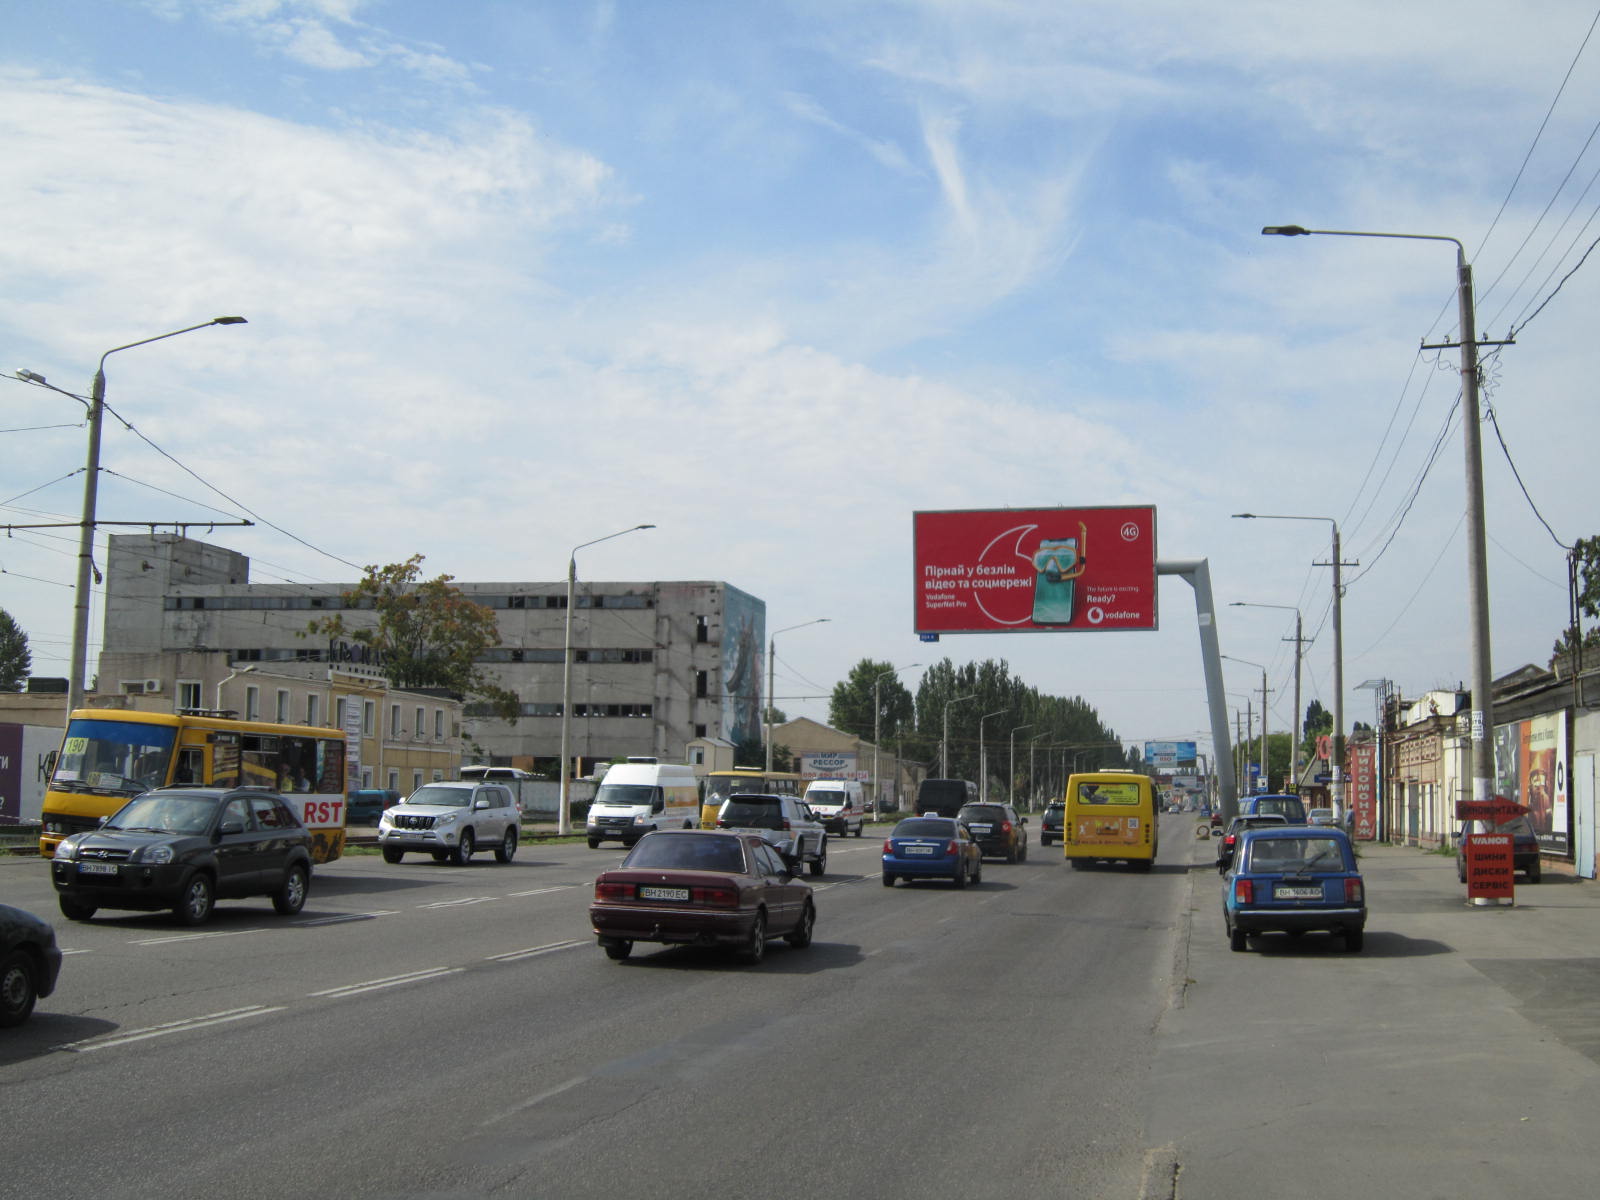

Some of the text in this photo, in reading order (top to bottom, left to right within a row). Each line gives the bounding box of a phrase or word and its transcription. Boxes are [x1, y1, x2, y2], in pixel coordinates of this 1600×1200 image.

[1123, 527, 1137, 537] 4G
[925, 564, 1016, 578] Пірнай у безлім
[925, 577, 1032, 590] відео та соцмережі
[1087, 594, 1116, 604] Ready?
[926, 601, 955, 609] SuperNet
[1104, 611, 1140, 619] vodafone
[67, 739, 84, 752] 190
[1357, 748, 1371, 836] ШИНОМОНТАЖ
[303, 801, 343, 824] RST
[1474, 853, 1507, 861] ШИНИ
[1473, 867, 1509, 876] ДИСКИ
[1473, 881, 1509, 889] СЕРВІС
